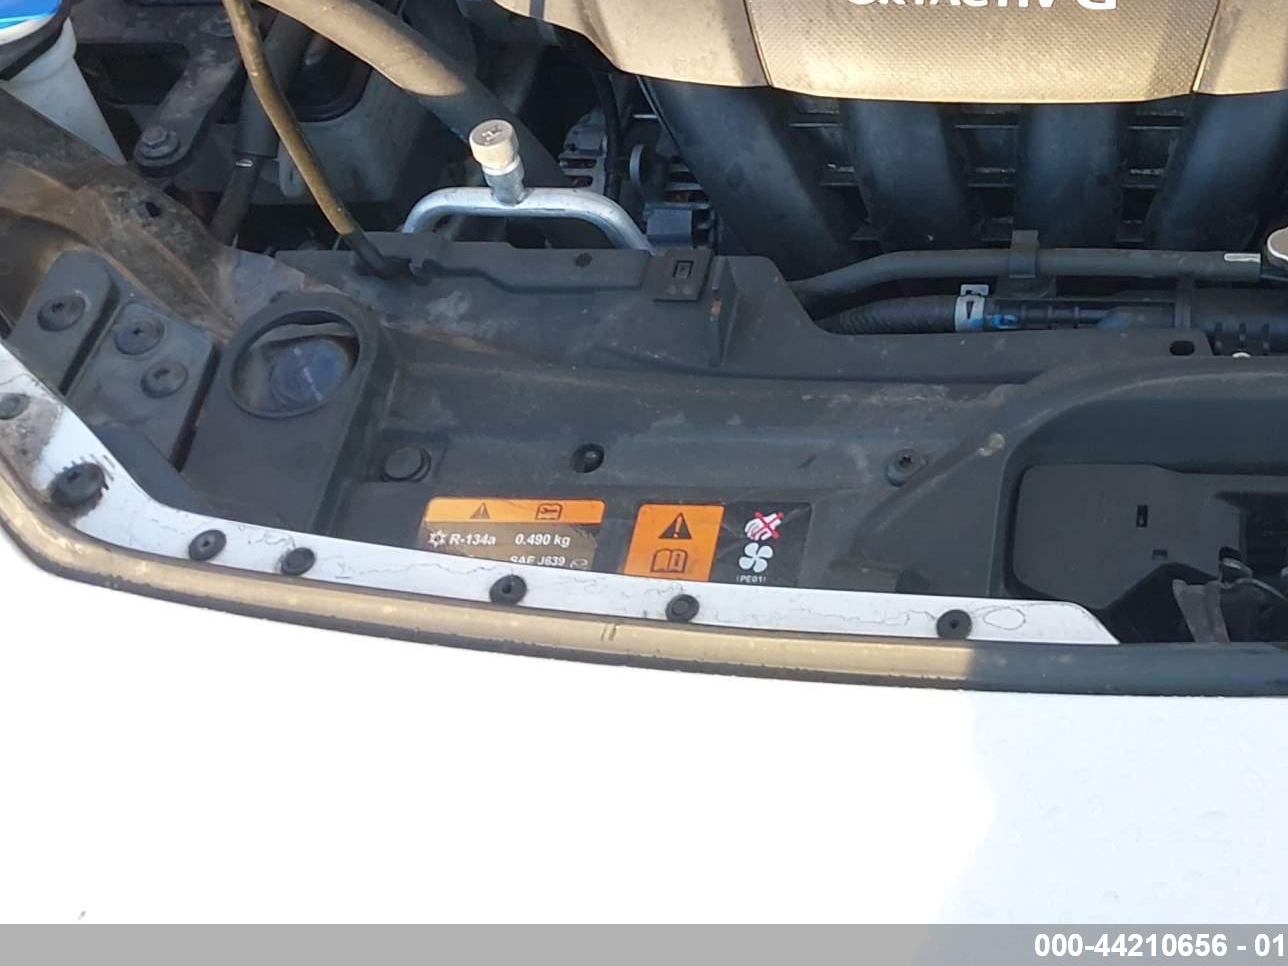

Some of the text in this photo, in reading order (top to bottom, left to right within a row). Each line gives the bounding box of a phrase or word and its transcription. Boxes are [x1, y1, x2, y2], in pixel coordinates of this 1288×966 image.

[449, 533, 571, 548] R-134a 0.490 kg
[537, 555, 566, 566] J639
